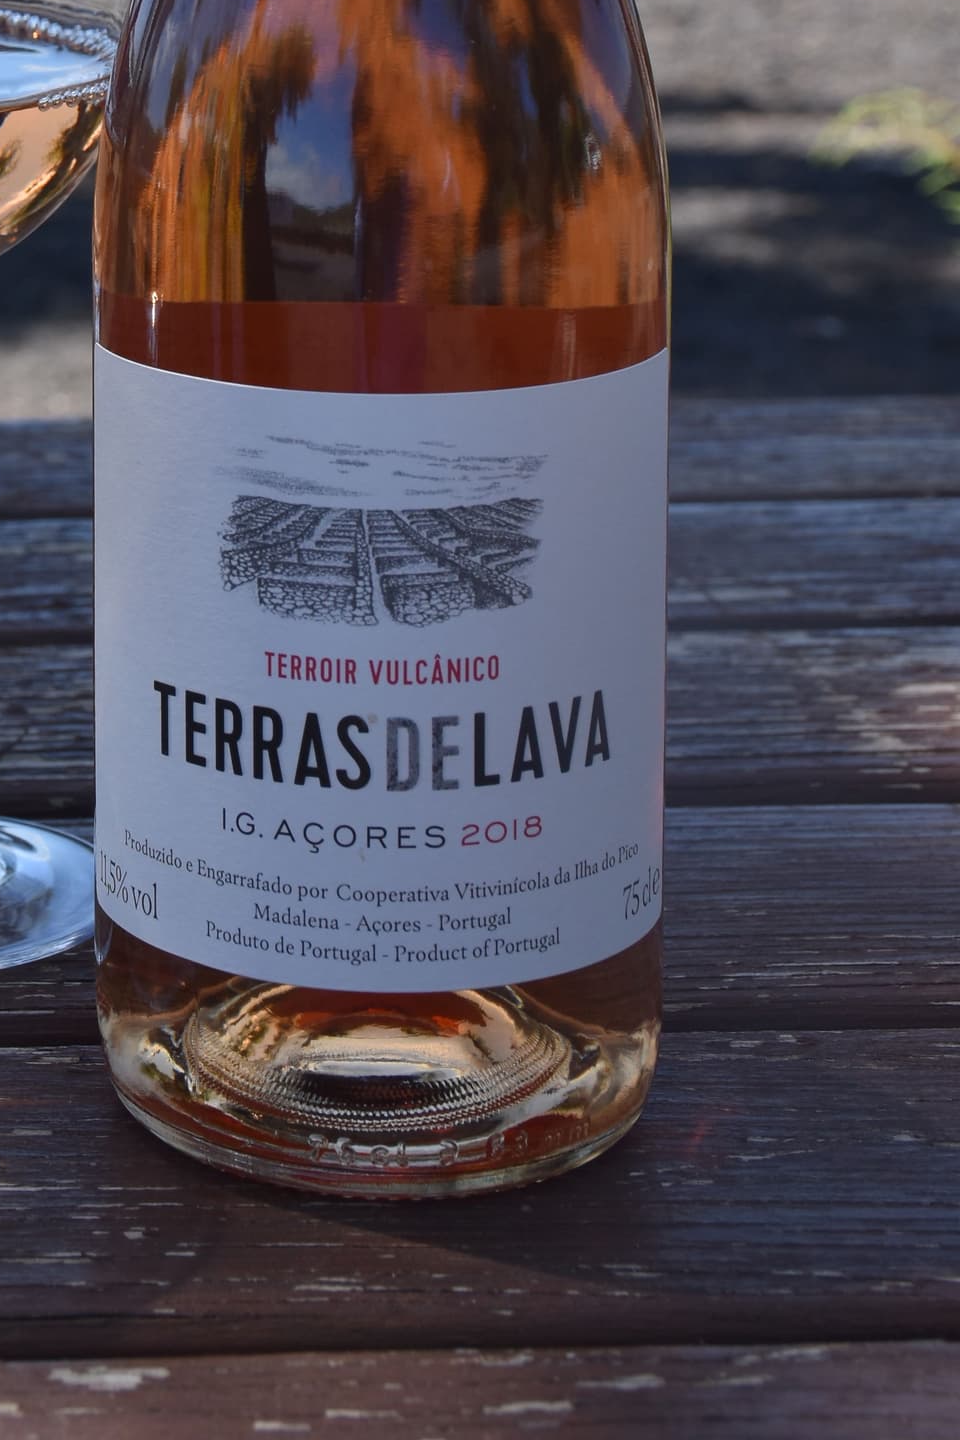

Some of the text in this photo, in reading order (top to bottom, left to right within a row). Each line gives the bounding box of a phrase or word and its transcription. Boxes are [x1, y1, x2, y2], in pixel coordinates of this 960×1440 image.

[264, 651, 499, 685] TERROIR VULCÂNICO
[223, 808, 542, 854] I.G. AÇORES 2018
[124, 829, 638, 907] Produzido e Engarrafado por Cooperativa Vitivinícola da Ilha do Pico
[253, 901, 339, 930] Madalena
[356, 915, 421, 936] Açores
[439, 906, 511, 932] Portugal
[206, 920, 271, 951] Produto
[275, 936, 294, 955] de
[300, 940, 376, 966] Portugal
[394, 944, 468, 962] Product
[472, 938, 491, 958] of
[494, 927, 560, 953] Portugal
